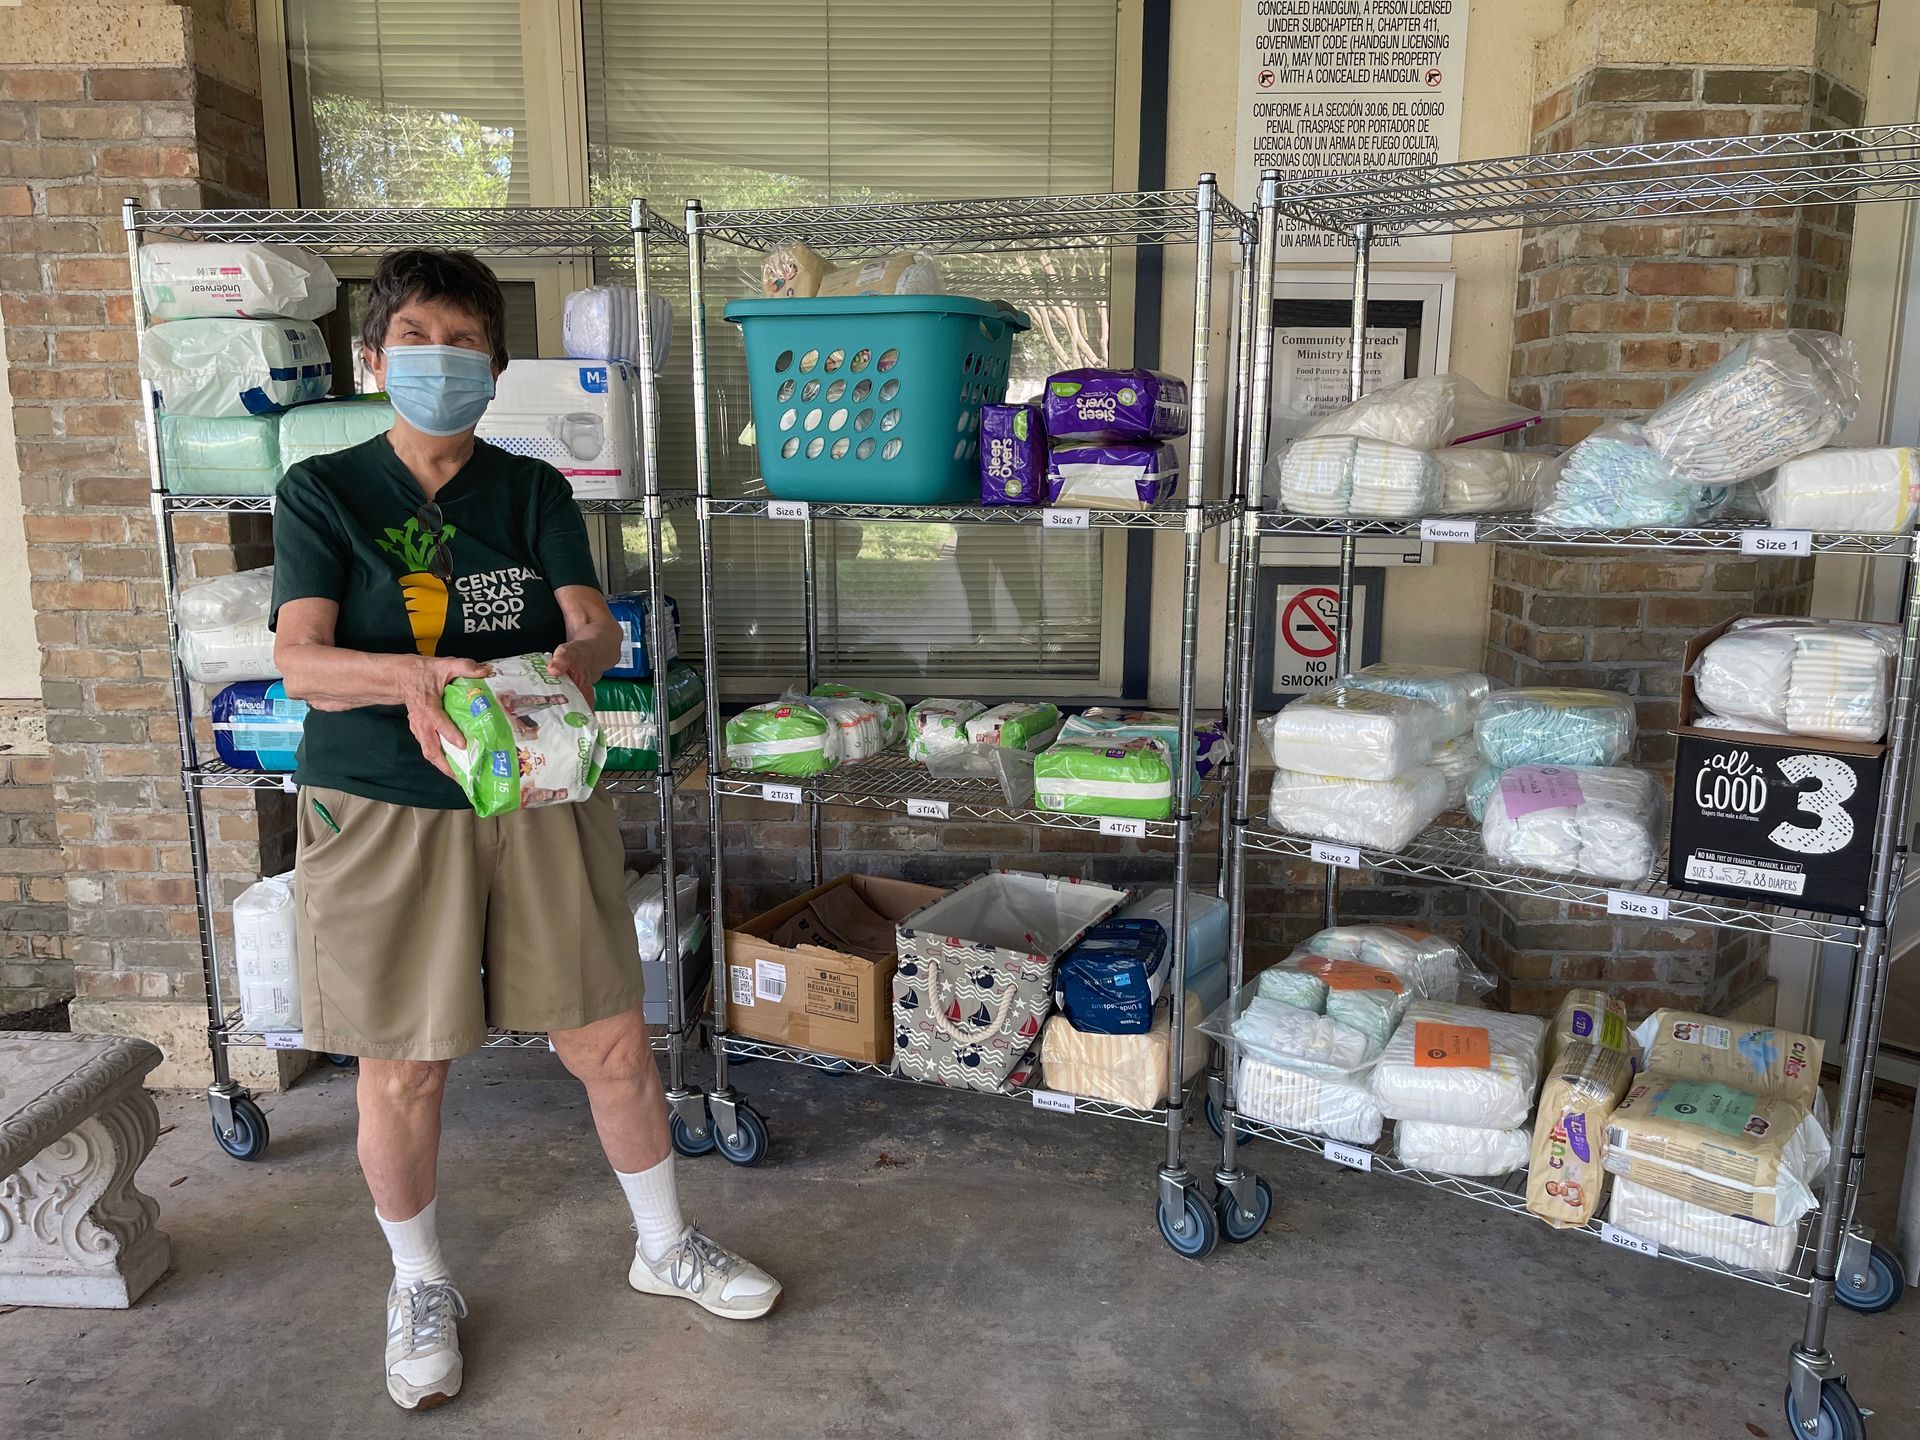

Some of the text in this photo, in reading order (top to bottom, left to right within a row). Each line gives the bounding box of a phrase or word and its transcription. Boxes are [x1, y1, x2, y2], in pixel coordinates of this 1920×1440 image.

[1257, 0, 1452, 18] CONCEALED HANDGUN), A PERSON LICENSED
[1267, 18, 1440, 33] UNDER SUBCHAPTER H, CHAPTER 411,
[1256, 35, 1450, 52] GOVERNMENT CODE (HANDGUN LICENSING
[1263, 52, 1441, 69] LAW), MAY NOT ENTER THIS PROPERTY
[1280, 69, 1421, 83] WITH A CONCEALED HANDGUN.
[1253, 99, 1444, 118] CONFORME A LA SECCIÓN 30.06, DEL CÓDIGO
[1266, 119, 1429, 135] PENAL (TRASPASE POR PORTADOR DE
[1253, 136, 1439, 151] LICENCIA CON UN ARMA DE FUEGO OCULTA),
[1254, 152, 1438, 166] PERSONAS CON LICENCIA BAJO AUTORIDAD
[1280, 235, 1293, 247] UN
[1295, 234, 1321, 247] ARMA
[1323, 234, 1335, 247] DE
[190, 284, 241, 293] Underwear
[1282, 336, 1346, 346] Community
[1297, 350, 1346, 361] Ministry
[586, 371, 599, 383] M
[1296, 367, 1314, 375] Food
[1316, 367, 1340, 376] Pantry
[1076, 397, 1117, 408] Overs
[1078, 408, 1116, 422] Sleep
[989, 439, 1003, 477] Sleep
[1000, 438, 1013, 478] Overs
[776, 507, 802, 516] Size 6
[1052, 516, 1082, 525] Size 7
[1429, 528, 1469, 538] Newborn
[1756, 538, 1798, 551] Size 1
[455, 566, 543, 592] CENTRAL
[458, 582, 524, 602] TEXAS
[462, 597, 525, 617] FOOD
[463, 613, 521, 634] BANK
[1306, 661, 1327, 672] NO
[235, 699, 266, 709] Prevail
[1712, 750, 1754, 776] all
[771, 791, 794, 801] 2T/3T
[1696, 767, 1767, 813] GOOD
[1768, 754, 1858, 854] 3
[1701, 809, 1716, 817] Diapers
[1109, 823, 1137, 833] 4T/5T
[1319, 851, 1350, 864] Size 2
[1692, 866, 1706, 878] SIZE
[1708, 866, 1714, 879] 3
[1752, 872, 1766, 887] 88
[1768, 877, 1797, 892] DIAPERS
[1620, 900, 1659, 915] Size 3
[808, 983, 840, 994] REUSABLE
[842, 990, 856, 998] BAG
[1038, 1098, 1071, 1110] Bed Pads
[1570, 1120, 1582, 1133] 27
[1334, 1150, 1364, 1167] Size 4
[1611, 1234, 1649, 1252] Size 5
